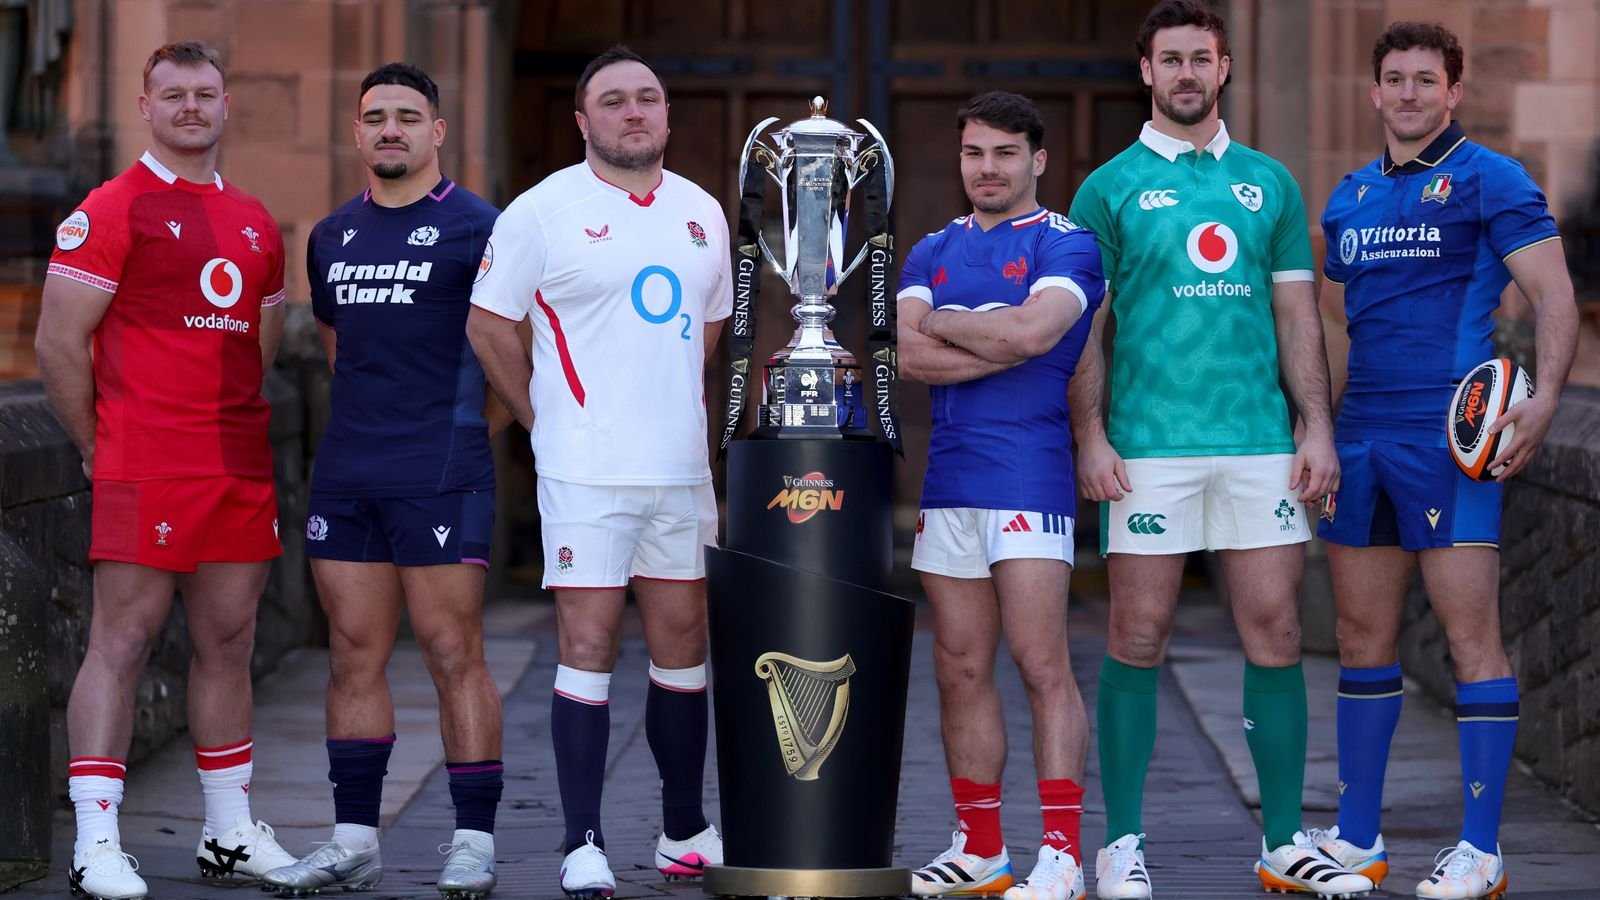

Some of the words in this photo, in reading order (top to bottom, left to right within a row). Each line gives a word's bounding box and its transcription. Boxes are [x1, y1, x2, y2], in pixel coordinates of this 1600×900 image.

[1360, 223, 1441, 245] Vittoria
[1360, 247, 1441, 261] Assicurazioni
[327, 260, 433, 283] Arnold
[335, 283, 417, 305] Clark
[734, 258, 754, 336] GUINNESS
[871, 249, 886, 327] GUINNESS
[1172, 280, 1251, 298] vodafone
[183, 313, 250, 333] vodafone
[800, 390, 819, 398] FFR
[875, 364, 897, 439] GUINNESS
[720, 374, 745, 450] GUINNESS
[792, 478, 834, 488] GUINNESS
[767, 488, 845, 511] M6N
[782, 737, 798, 763] 1759
